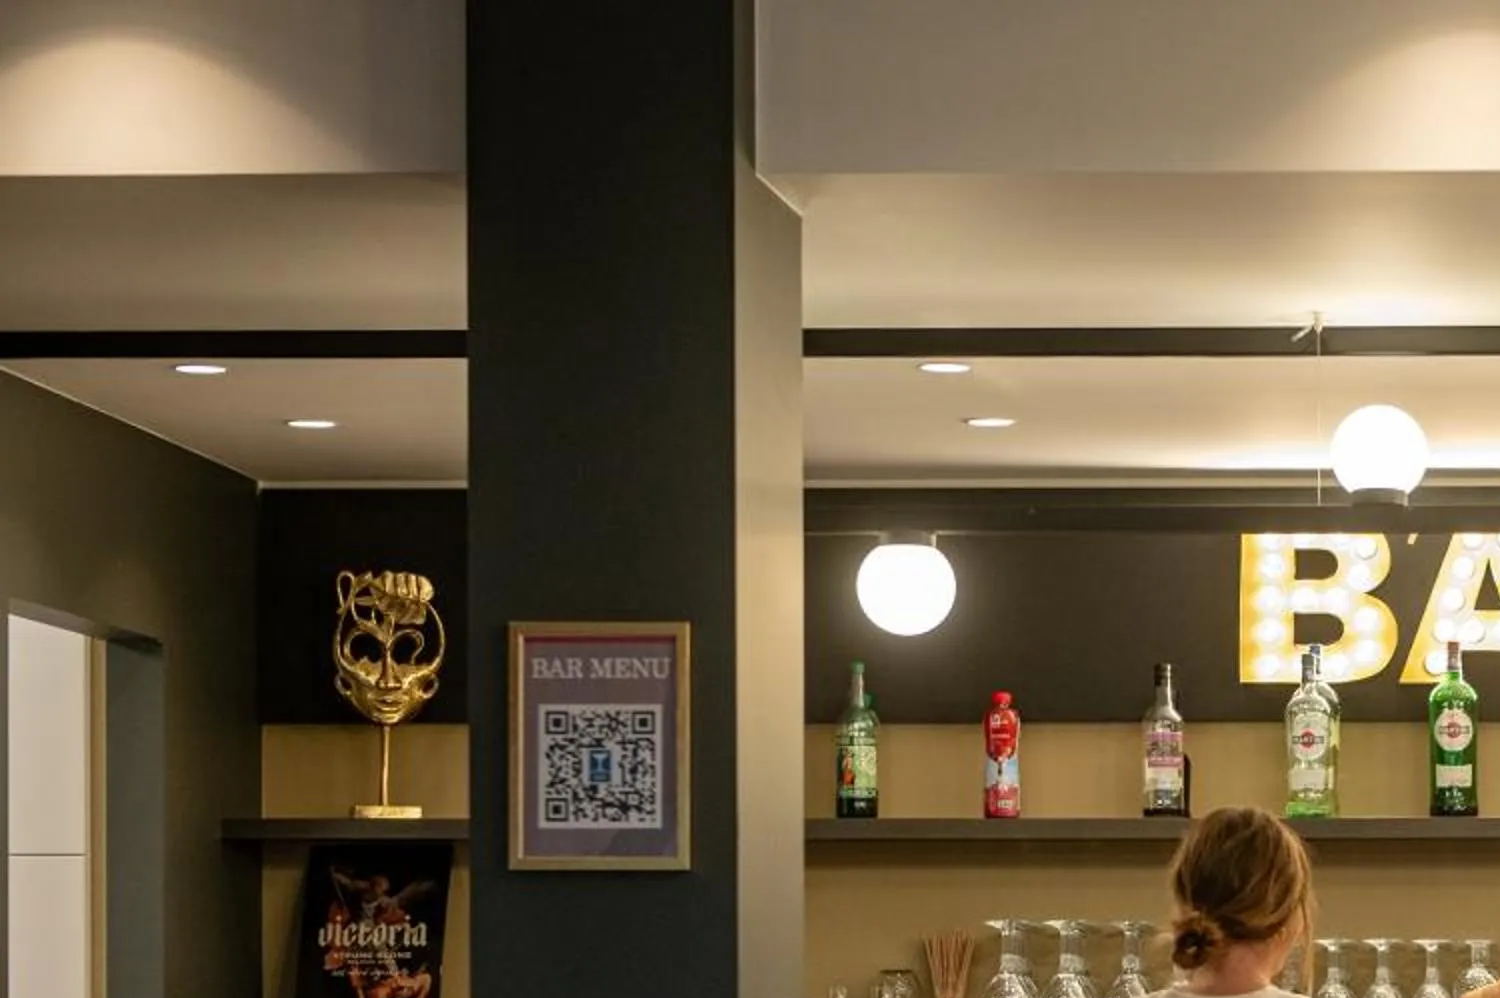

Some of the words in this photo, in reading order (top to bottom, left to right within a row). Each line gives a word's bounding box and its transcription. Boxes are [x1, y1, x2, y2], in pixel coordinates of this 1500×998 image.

[531, 657, 583, 679] BAR
[589, 657, 672, 679] MENU
[317, 914, 428, 947] victoria
